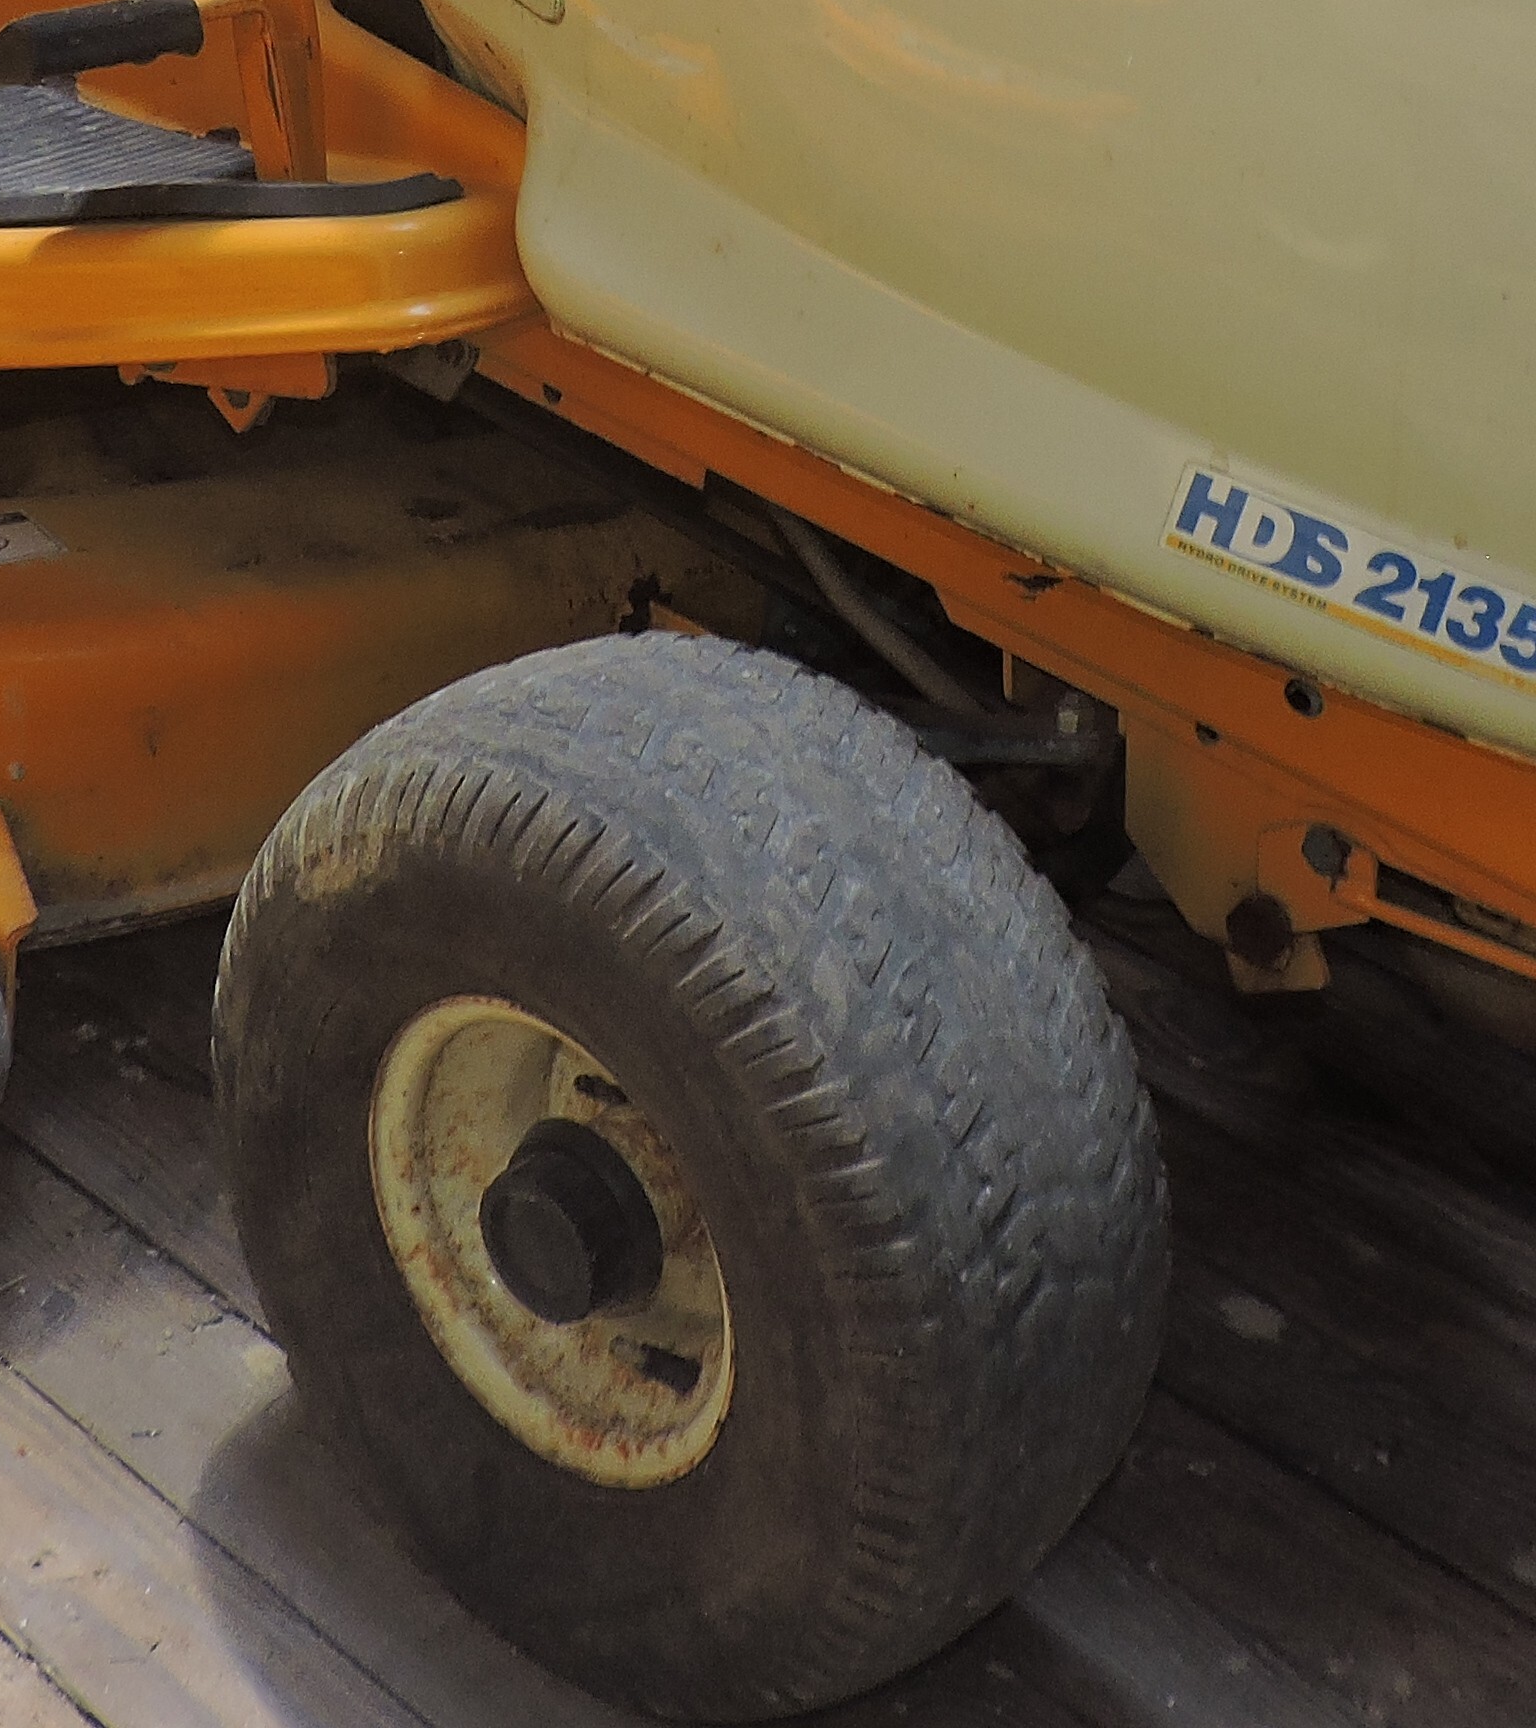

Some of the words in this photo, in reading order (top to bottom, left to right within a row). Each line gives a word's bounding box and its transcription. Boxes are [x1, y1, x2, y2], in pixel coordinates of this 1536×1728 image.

[1175, 472, 1348, 588] HDS
[1177, 540, 1224, 569] HYDRO
[1227, 563, 1269, 587] DRIVE
[1272, 581, 1328, 610] SYSTEM
